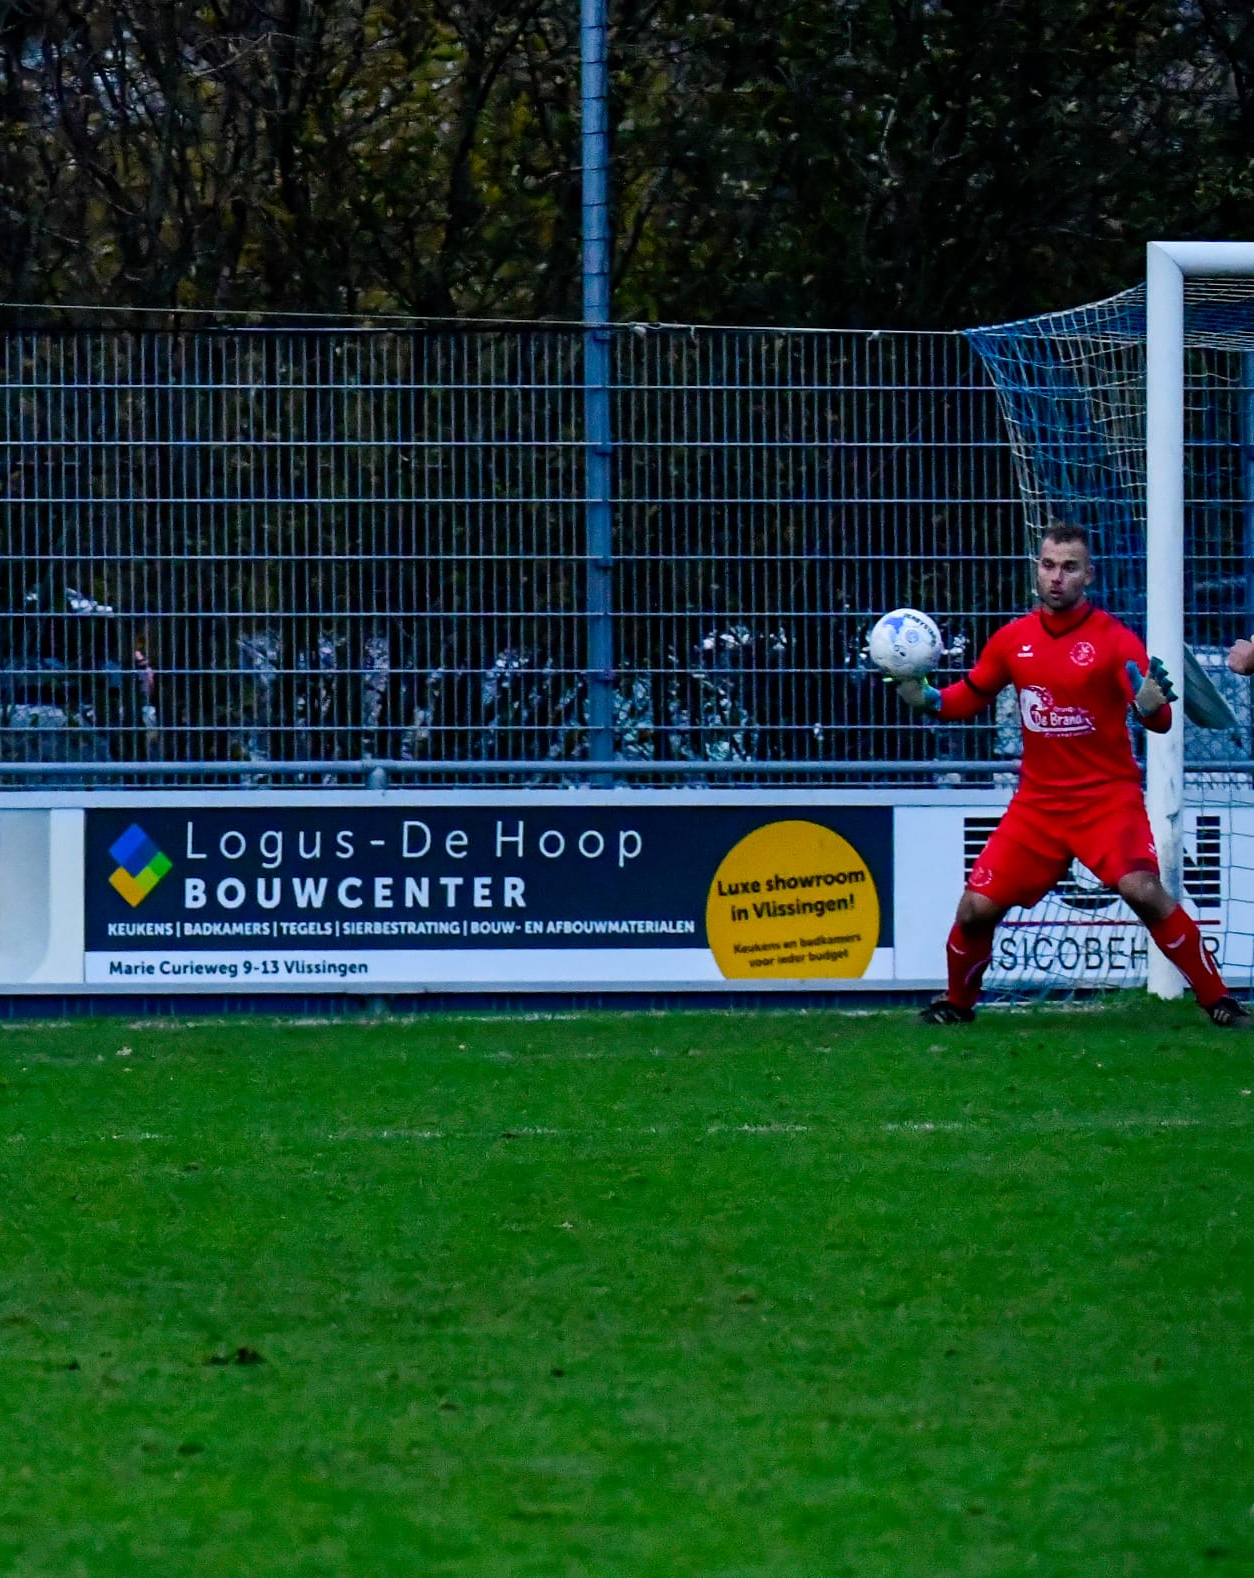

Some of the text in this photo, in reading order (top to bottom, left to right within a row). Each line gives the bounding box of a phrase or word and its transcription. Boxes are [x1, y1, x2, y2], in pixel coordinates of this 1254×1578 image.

[496, 820, 643, 868] Hoop
[184, 876, 526, 909] BOUWCENTER
[717, 869, 866, 897] Luxe showroom
[731, 894, 856, 922] in Vlissingen!
[107, 922, 174, 937] KEUKENS
[183, 921, 271, 936] BADKAMERS
[279, 921, 333, 936] TEGELS
[342, 920, 461, 936] SIERBESTRATING
[470, 920, 522, 935] BOUW-
[524, 920, 544, 935] EN
[545, 920, 695, 934] AFBOUWMATERIALEN
[109, 959, 369, 978] Marie Curieweg 9-13 Vlissingen
